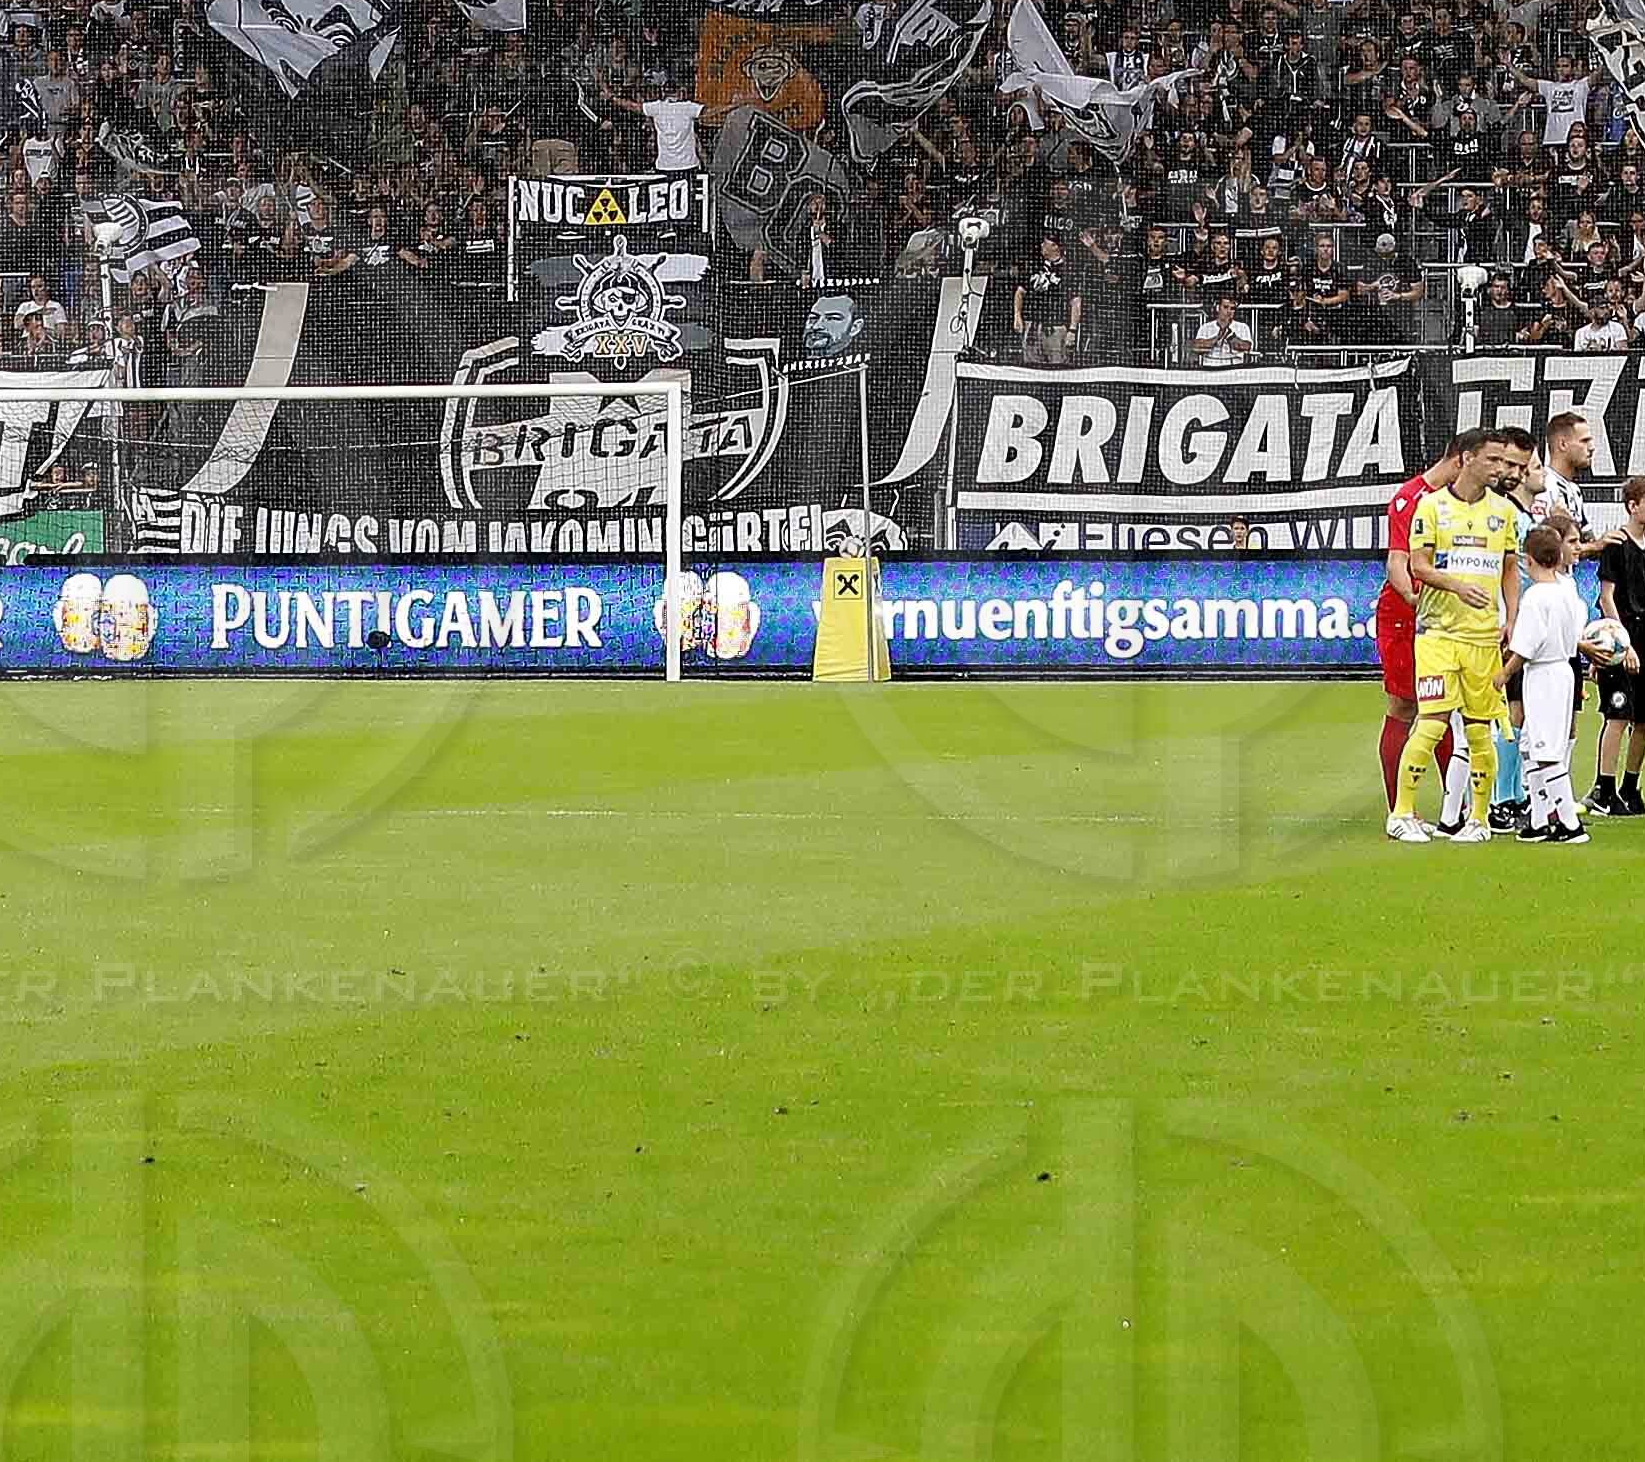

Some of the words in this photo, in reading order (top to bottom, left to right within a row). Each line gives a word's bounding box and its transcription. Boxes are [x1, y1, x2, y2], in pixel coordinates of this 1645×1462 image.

[594, 334, 649, 355] XXV
[976, 387, 1406, 486] BRIGATA
[211, 584, 602, 649] PUNTIGAMER
